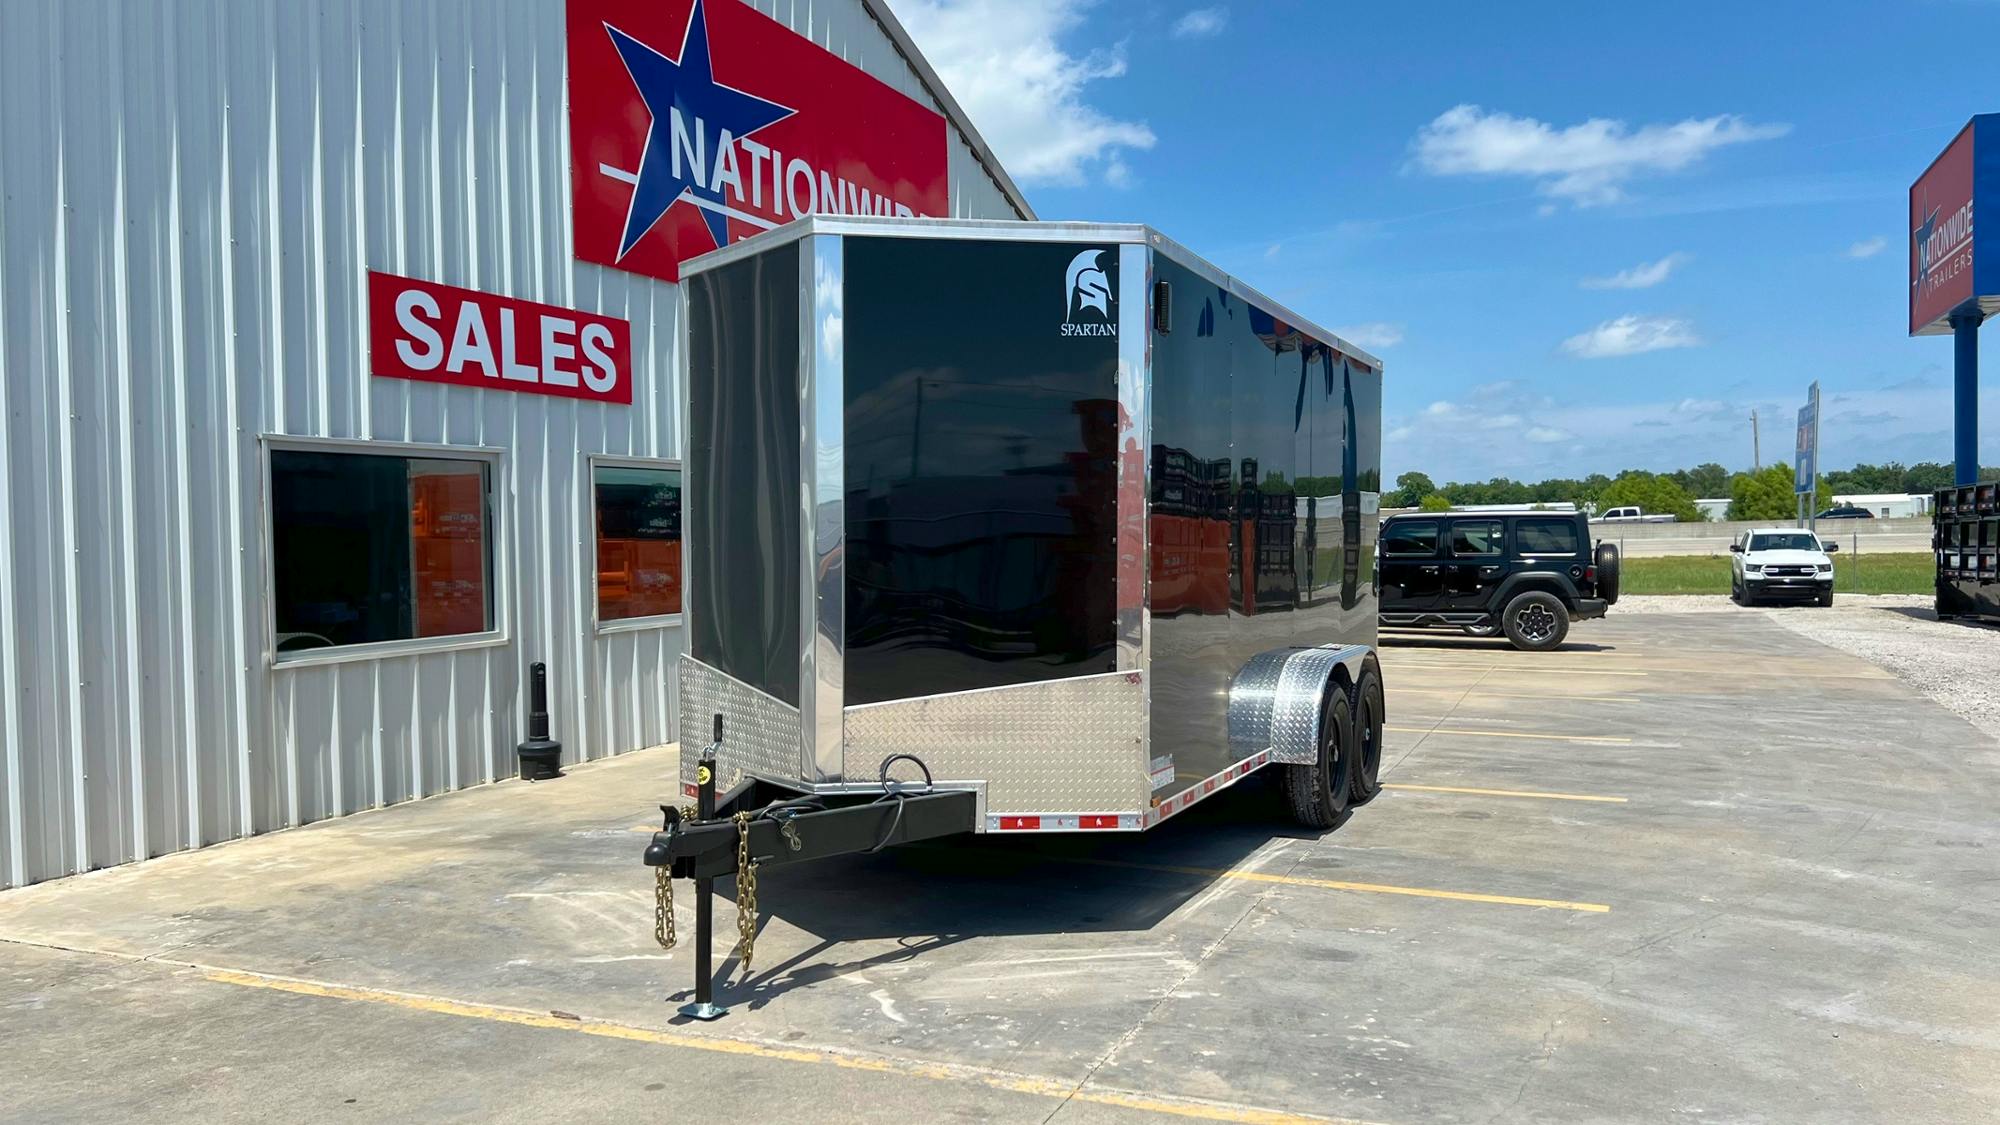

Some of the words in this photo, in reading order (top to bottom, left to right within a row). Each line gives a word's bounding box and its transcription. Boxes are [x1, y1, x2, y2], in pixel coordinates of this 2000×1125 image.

[1919, 199, 1974, 272] NATIONWIDE
[1928, 248, 1973, 292] TRAILERS
[394, 289, 617, 393] SALES
[1060, 323, 1117, 337] SPARTAN
